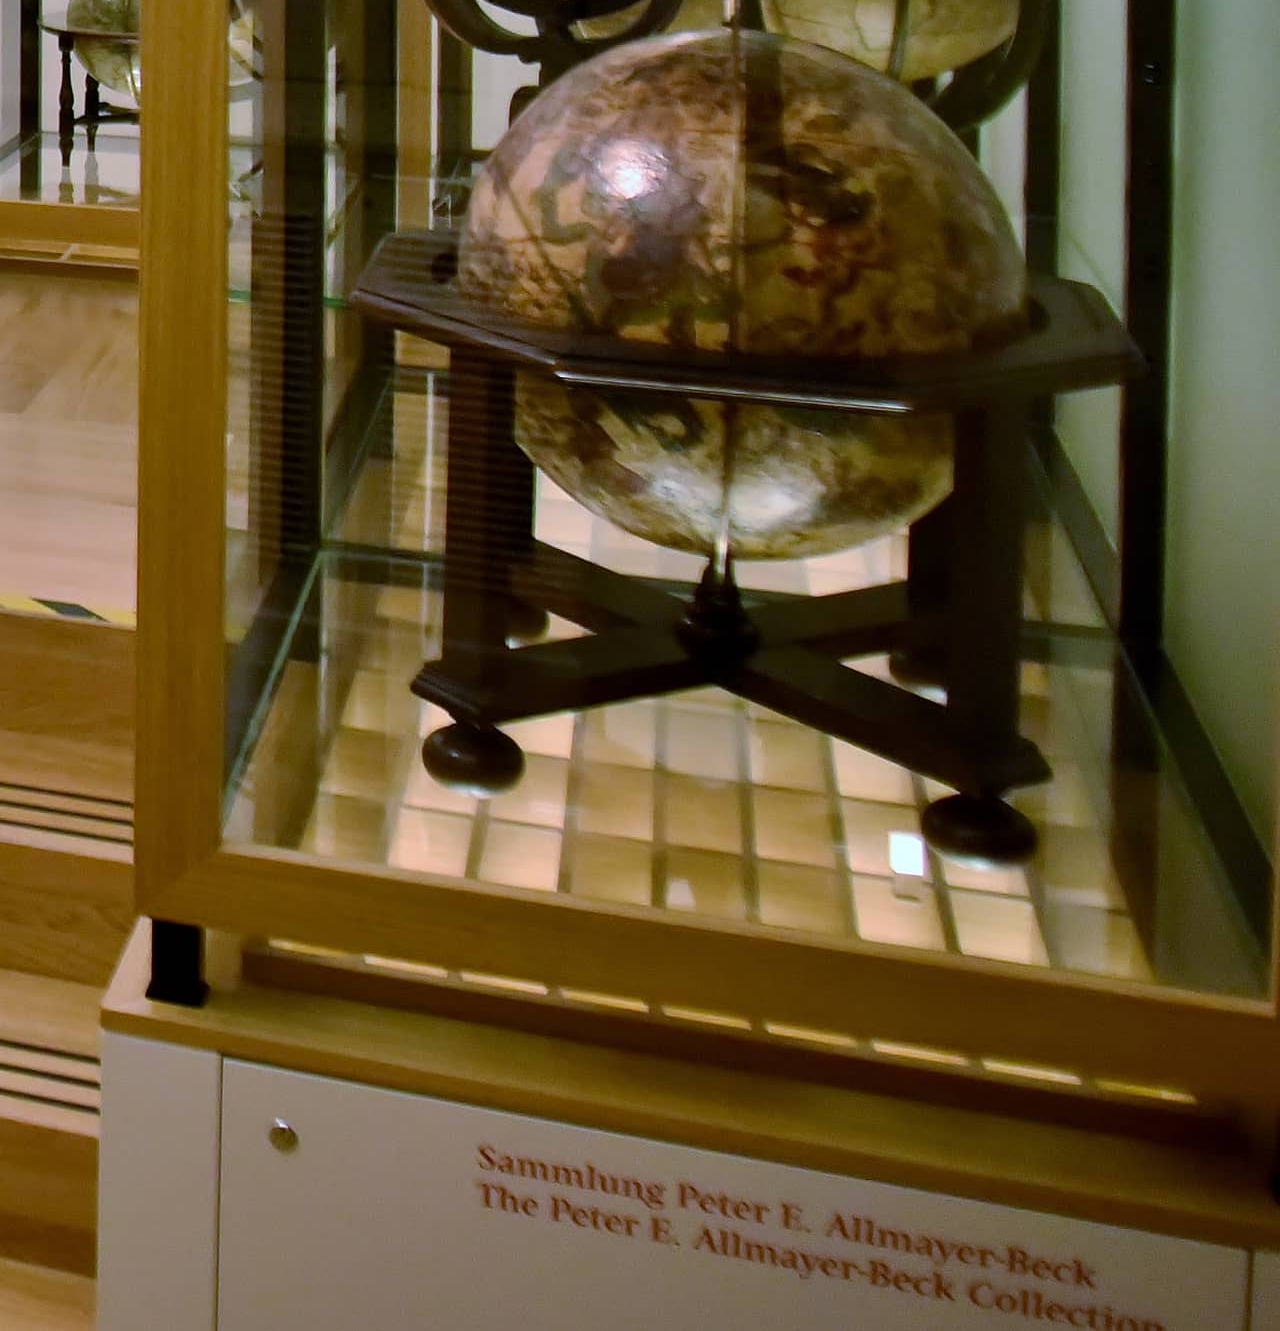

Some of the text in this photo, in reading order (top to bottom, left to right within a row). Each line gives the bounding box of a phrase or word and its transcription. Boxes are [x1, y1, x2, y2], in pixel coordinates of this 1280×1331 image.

[478, 1143, 1097, 1289] Sammlung Peter E. Allmayer-Beck
[479, 1181, 538, 1217] The
[551, 1196, 640, 1237] Peter
[650, 1217, 680, 1247] E.
[694, 1225, 957, 1301] Allmayer-Beck
